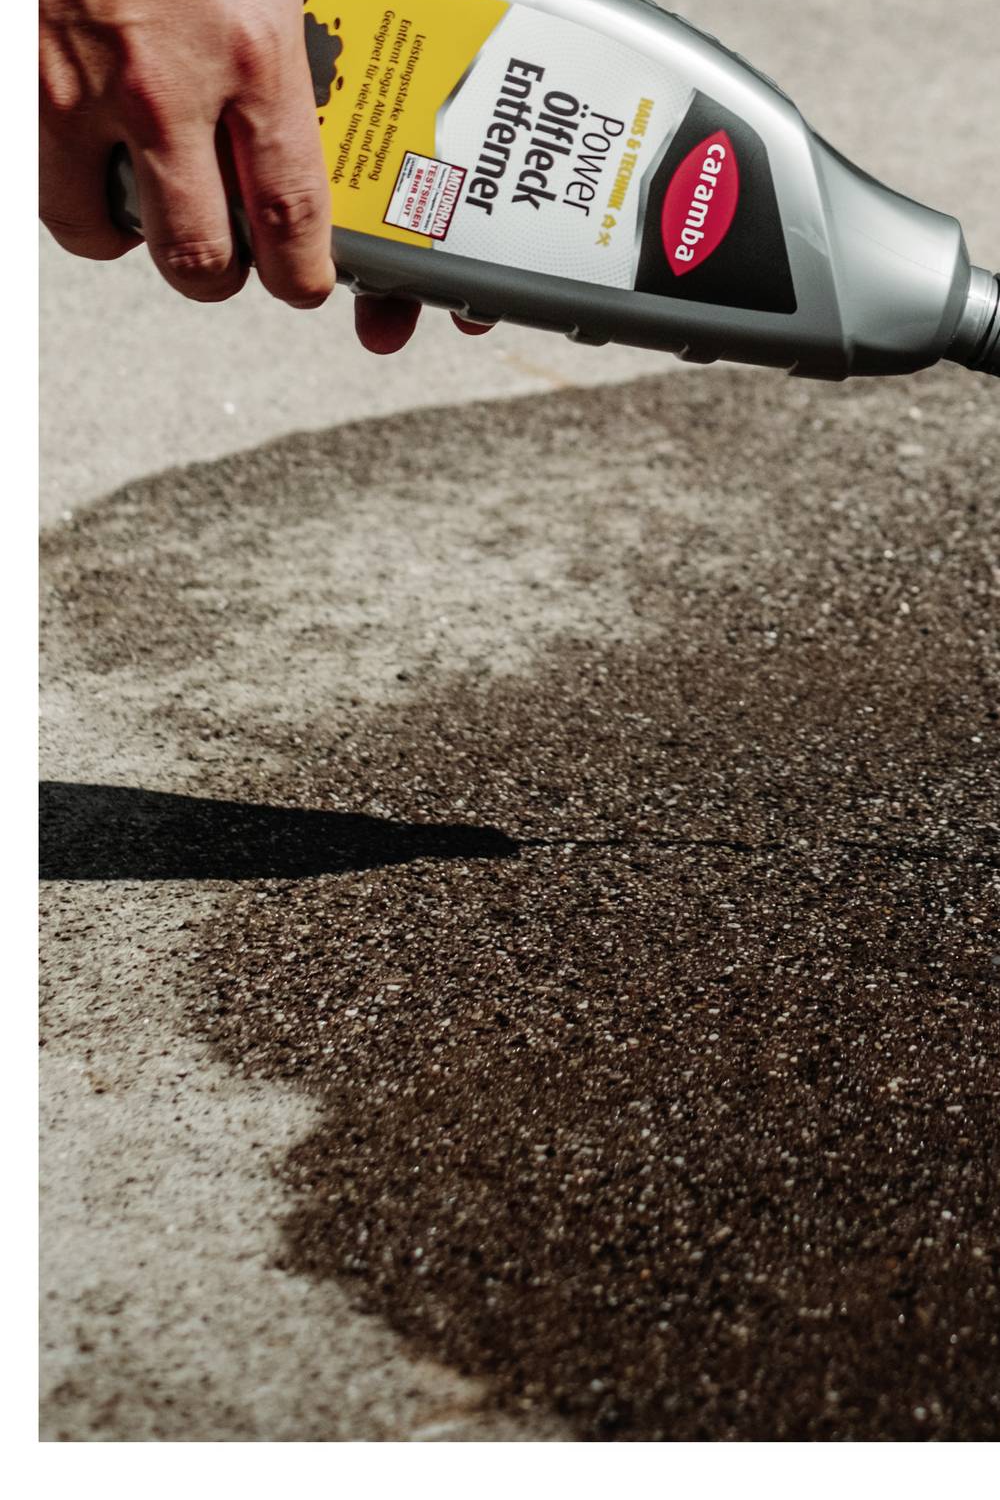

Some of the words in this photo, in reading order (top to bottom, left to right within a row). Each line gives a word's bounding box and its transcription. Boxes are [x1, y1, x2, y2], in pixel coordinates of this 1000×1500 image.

[370, 10, 396, 62] Geeignet
[388, 19, 412, 65] Entfernt
[355, 83, 371, 110] viele
[365, 64, 380, 80] für
[378, 67, 395, 98] sogar
[389, 34, 426, 122] Leistungsstarke
[369, 99, 386, 128] Altöl
[464, 57, 545, 216] Entferner
[630, 96, 655, 137] HAUS
[331, 113, 363, 184] Untergründe
[360, 129, 375, 153] und
[367, 123, 398, 182] Reinigung
[511, 90, 590, 210] Ölfleck
[562, 112, 625, 217] Power
[348, 154, 369, 190] Diesel
[410, 168, 424, 194] SEHR
[410, 165, 439, 229] TESTSIEGER
[607, 153, 637, 210] TECHNIK
[403, 196, 415, 217] GUT
[431, 168, 463, 237] MOTORRAD
[675, 144, 726, 262] caramba
